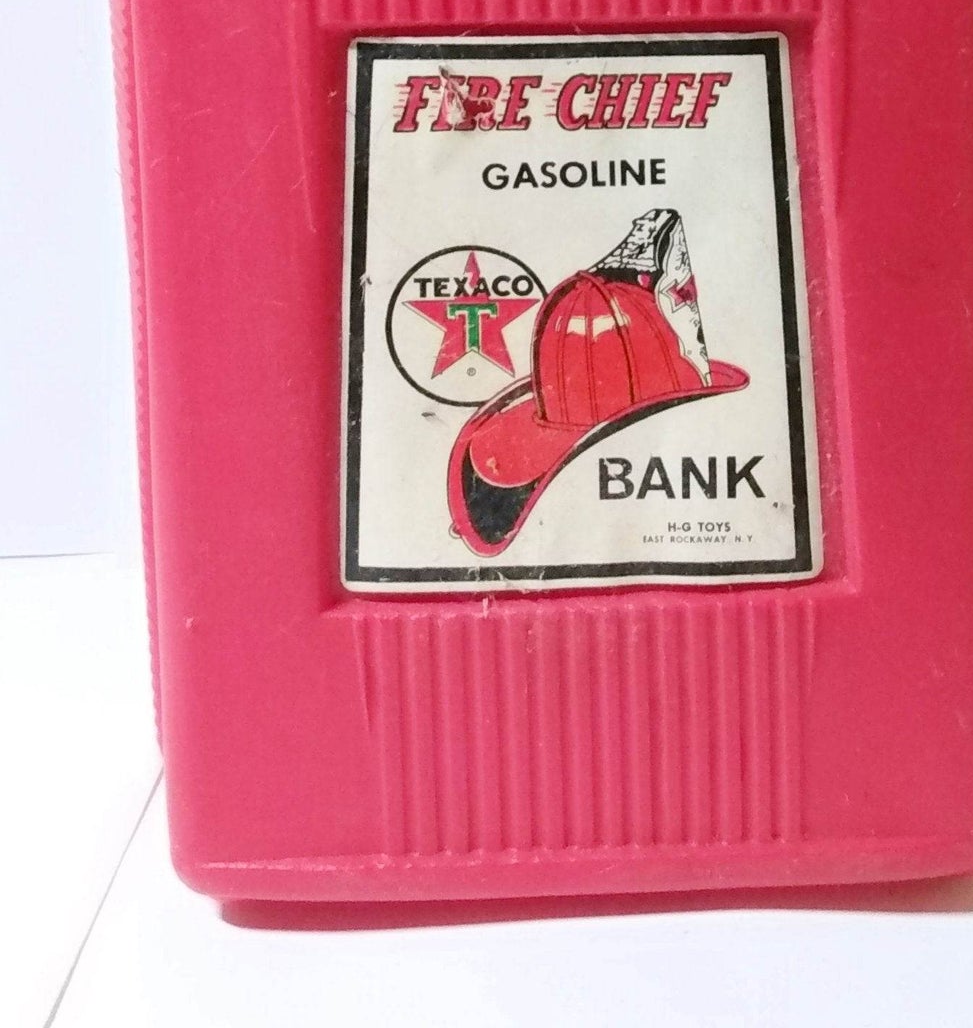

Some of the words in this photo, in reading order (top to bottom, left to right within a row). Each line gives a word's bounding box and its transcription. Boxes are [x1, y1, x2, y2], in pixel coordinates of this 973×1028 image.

[393, 73, 544, 133] FIRE
[556, 72, 733, 132] CHIEF
[481, 158, 667, 190] GASOLINE
[413, 274, 535, 298] TEXACO
[598, 455, 766, 501] BANK
[642, 535, 664, 544] EAST
[670, 535, 727, 544] ROCKAWAY
[667, 521, 692, 533] H-G
[697, 521, 731, 533] TOYS
